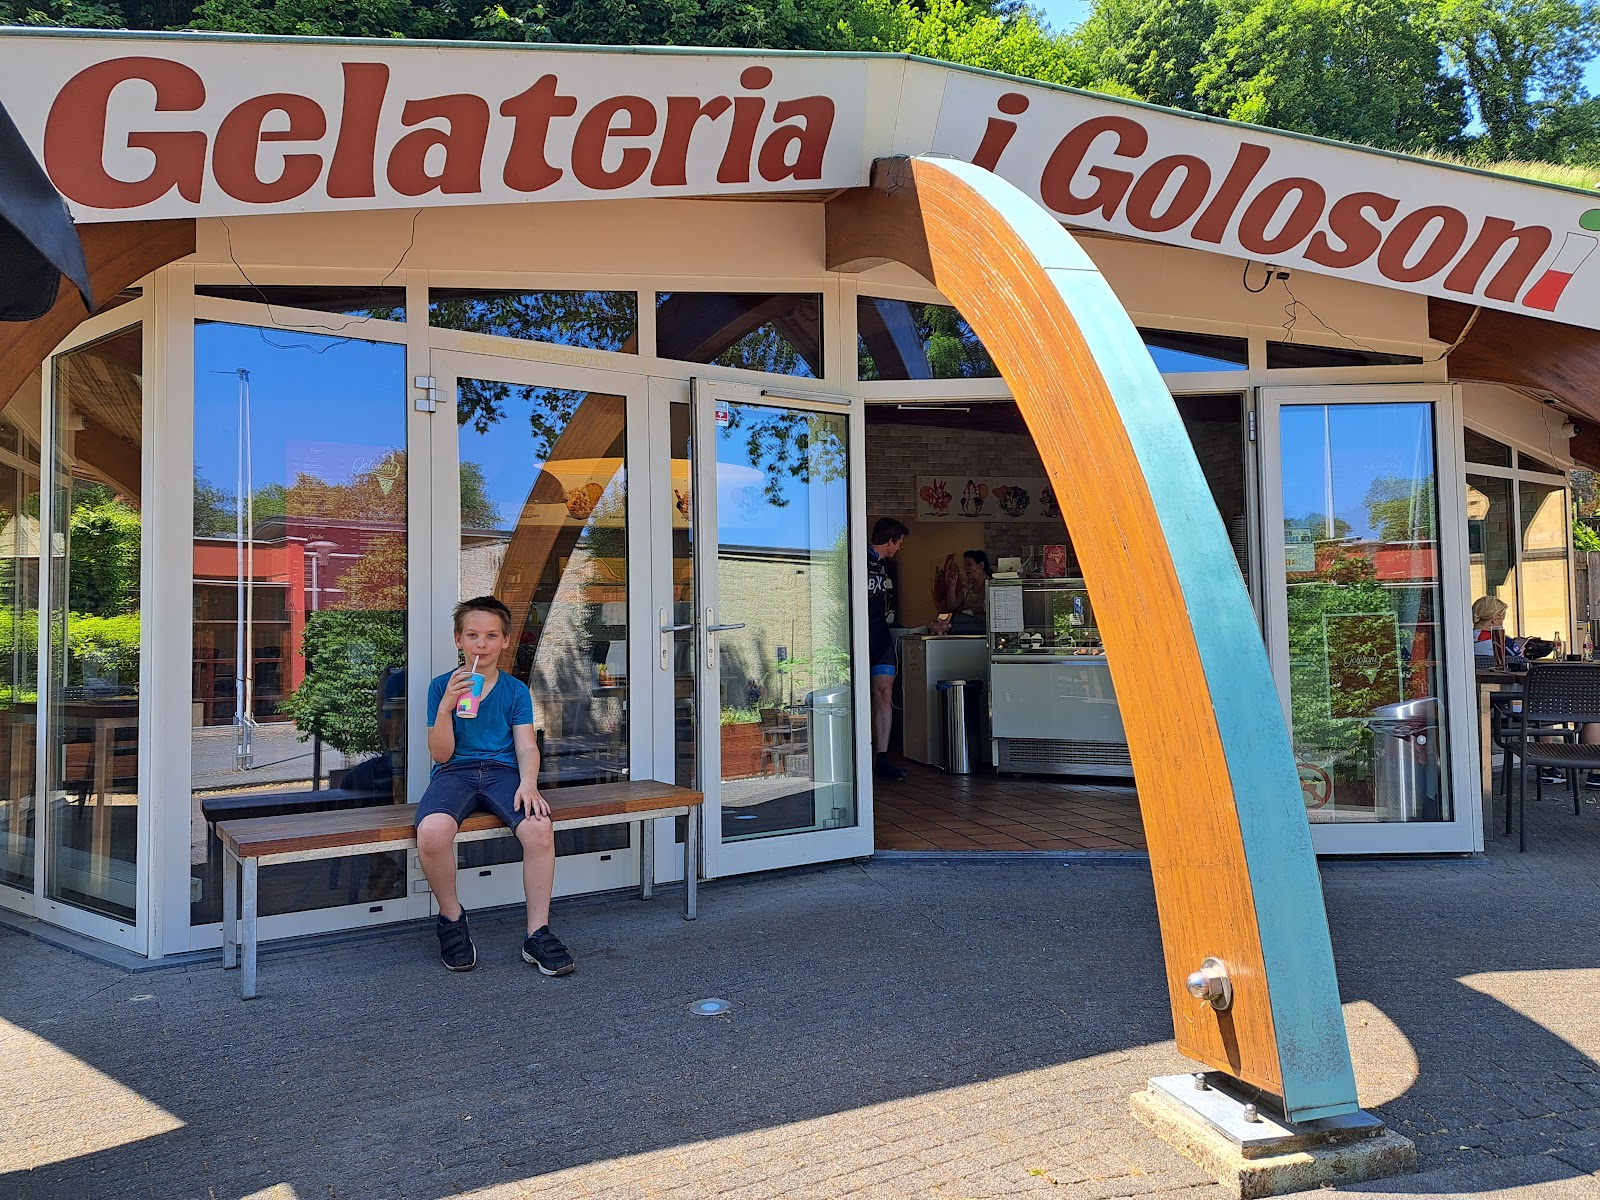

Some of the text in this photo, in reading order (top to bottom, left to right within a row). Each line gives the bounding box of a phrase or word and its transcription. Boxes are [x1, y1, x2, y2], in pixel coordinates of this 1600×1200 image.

[44, 56, 835, 209] Gelateria
[971, 92, 1600, 312] i Golosoni
